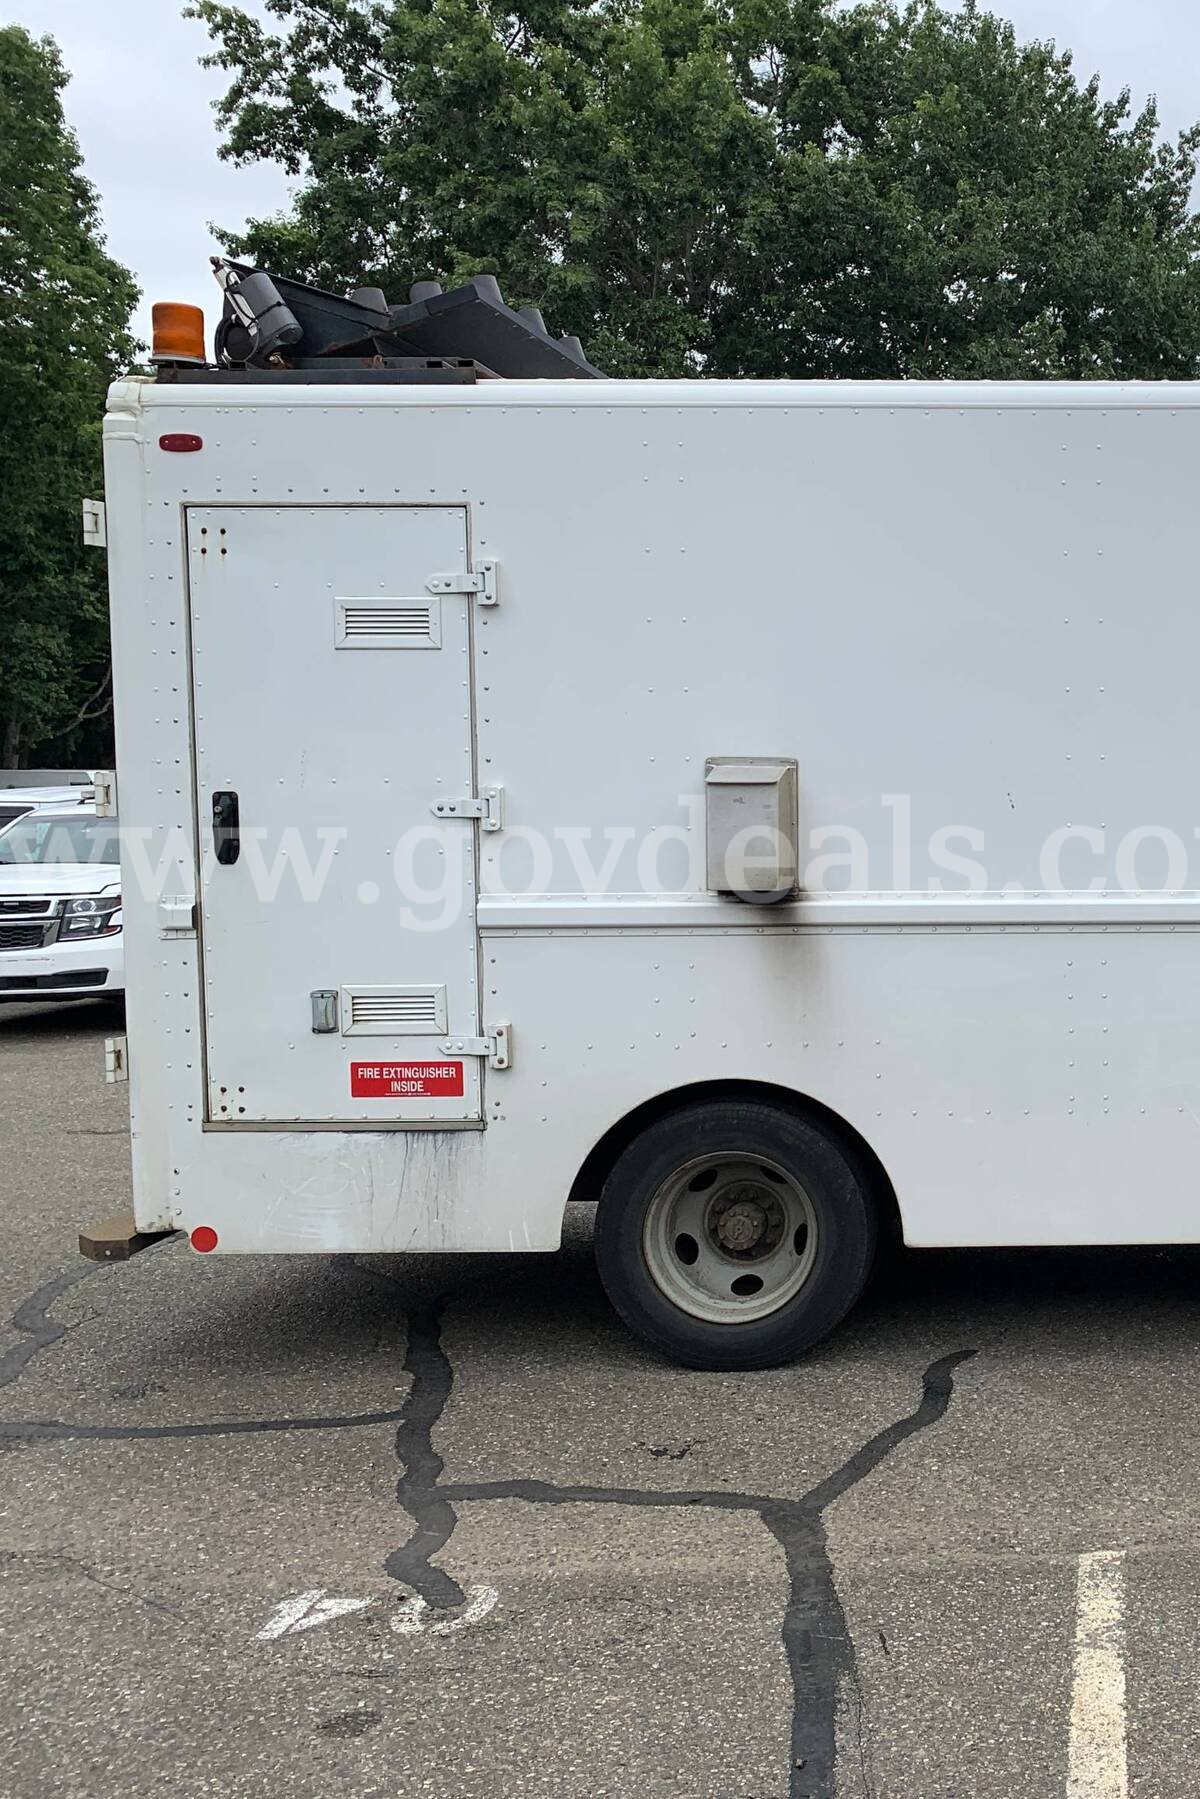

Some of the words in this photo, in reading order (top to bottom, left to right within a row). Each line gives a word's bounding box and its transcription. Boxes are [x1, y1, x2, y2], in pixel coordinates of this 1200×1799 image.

[358, 1067, 381, 1079] FIRE
[383, 1067, 456, 1078] EXTINGUISHER
[391, 1080, 424, 1092] INSIDE
